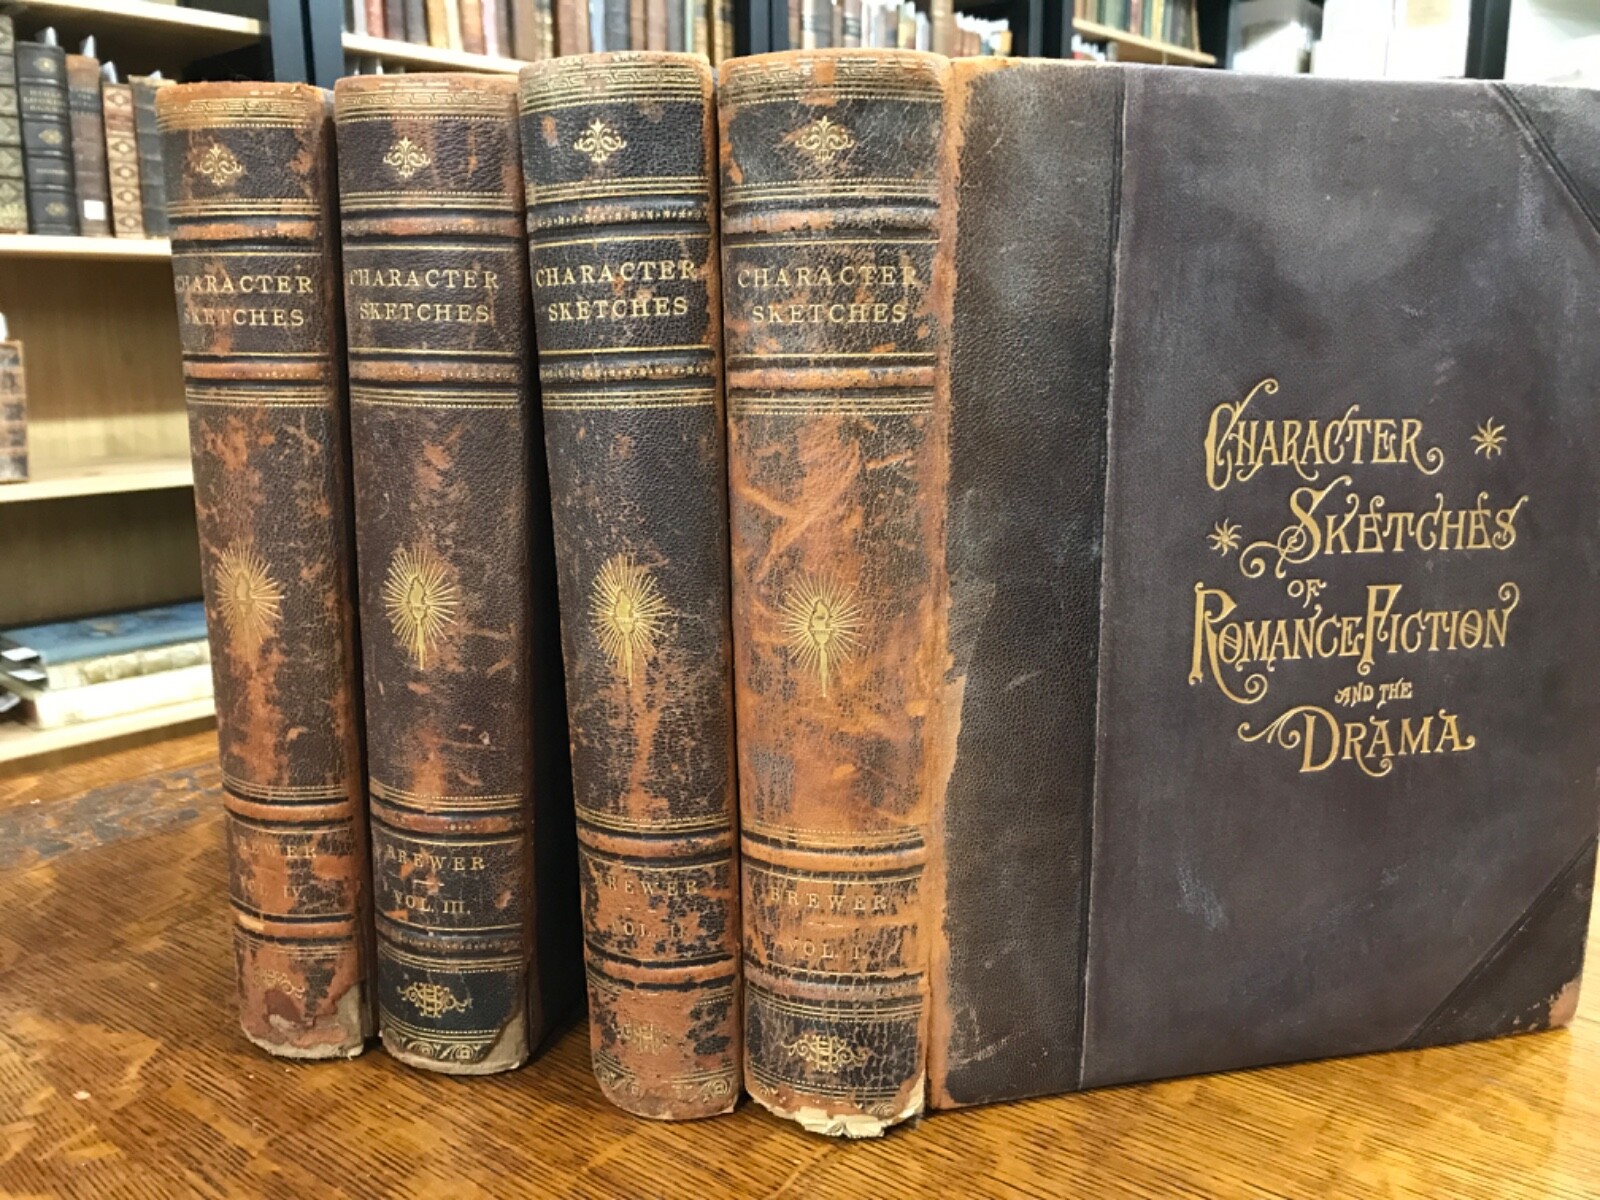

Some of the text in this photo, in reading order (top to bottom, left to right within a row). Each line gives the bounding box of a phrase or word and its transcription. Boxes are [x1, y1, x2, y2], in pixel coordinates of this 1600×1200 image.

[535, 260, 698, 288] CHARACTER
[737, 266, 917, 288] CHARACTER
[548, 297, 689, 322] SKETCHES
[752, 303, 908, 324] SKETCHES
[1204, 378, 1445, 491] CHARACTER
[1239, 475, 1530, 579] SKETCHES
[1188, 582, 1521, 705] ROMANCE FICTION
[1334, 677, 1414, 710] AND THE
[1237, 705, 1477, 778] DRAMA
[770, 886, 888, 911] BREWER
